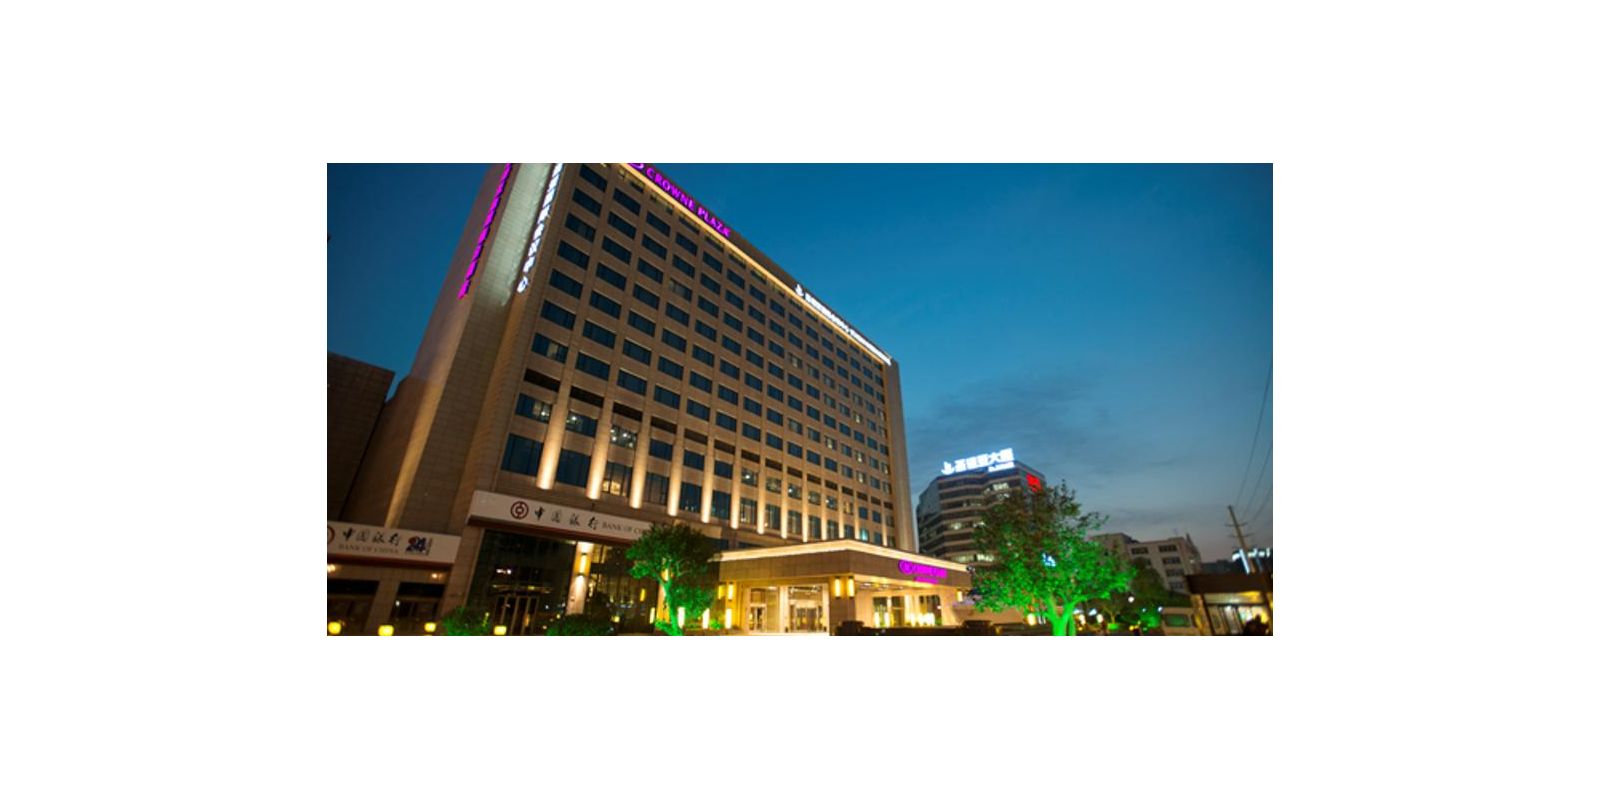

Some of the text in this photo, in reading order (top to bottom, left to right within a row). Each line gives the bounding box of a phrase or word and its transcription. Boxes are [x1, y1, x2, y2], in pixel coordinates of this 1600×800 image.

[645, 166, 732, 238] CROWNE PLAZA
[534, 506, 598, 530] 中国银行
[342, 527, 402, 546] 中国银行
